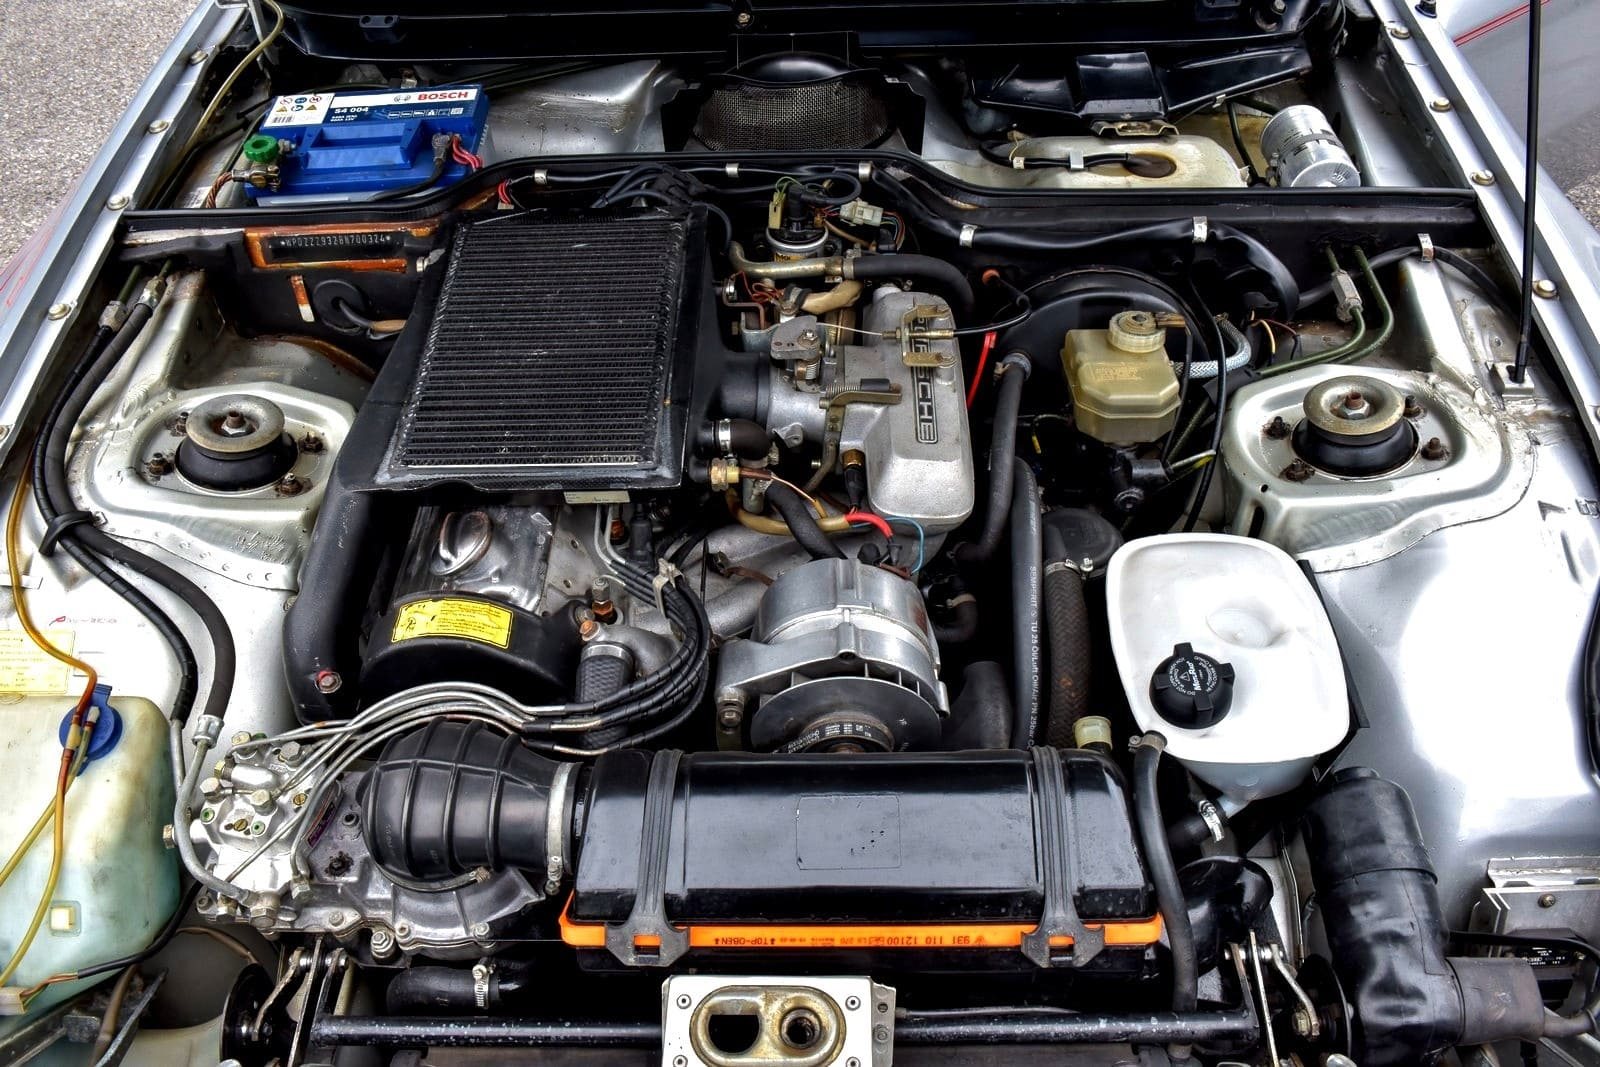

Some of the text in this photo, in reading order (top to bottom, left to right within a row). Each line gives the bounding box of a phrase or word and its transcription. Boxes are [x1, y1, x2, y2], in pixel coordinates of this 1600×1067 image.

[418, 91, 469, 101] BOSCH
[1030, 566, 1038, 607] SEMPERIT
[1031, 620, 1038, 632] TU
[1031, 634, 1038, 644] 25
[1031, 702, 1038, 714] PN
[721, 936, 768, 945] TOP-OBEN
[887, 935, 917, 946] 12100
[925, 935, 943, 945] 110
[952, 935, 971, 945] 931
